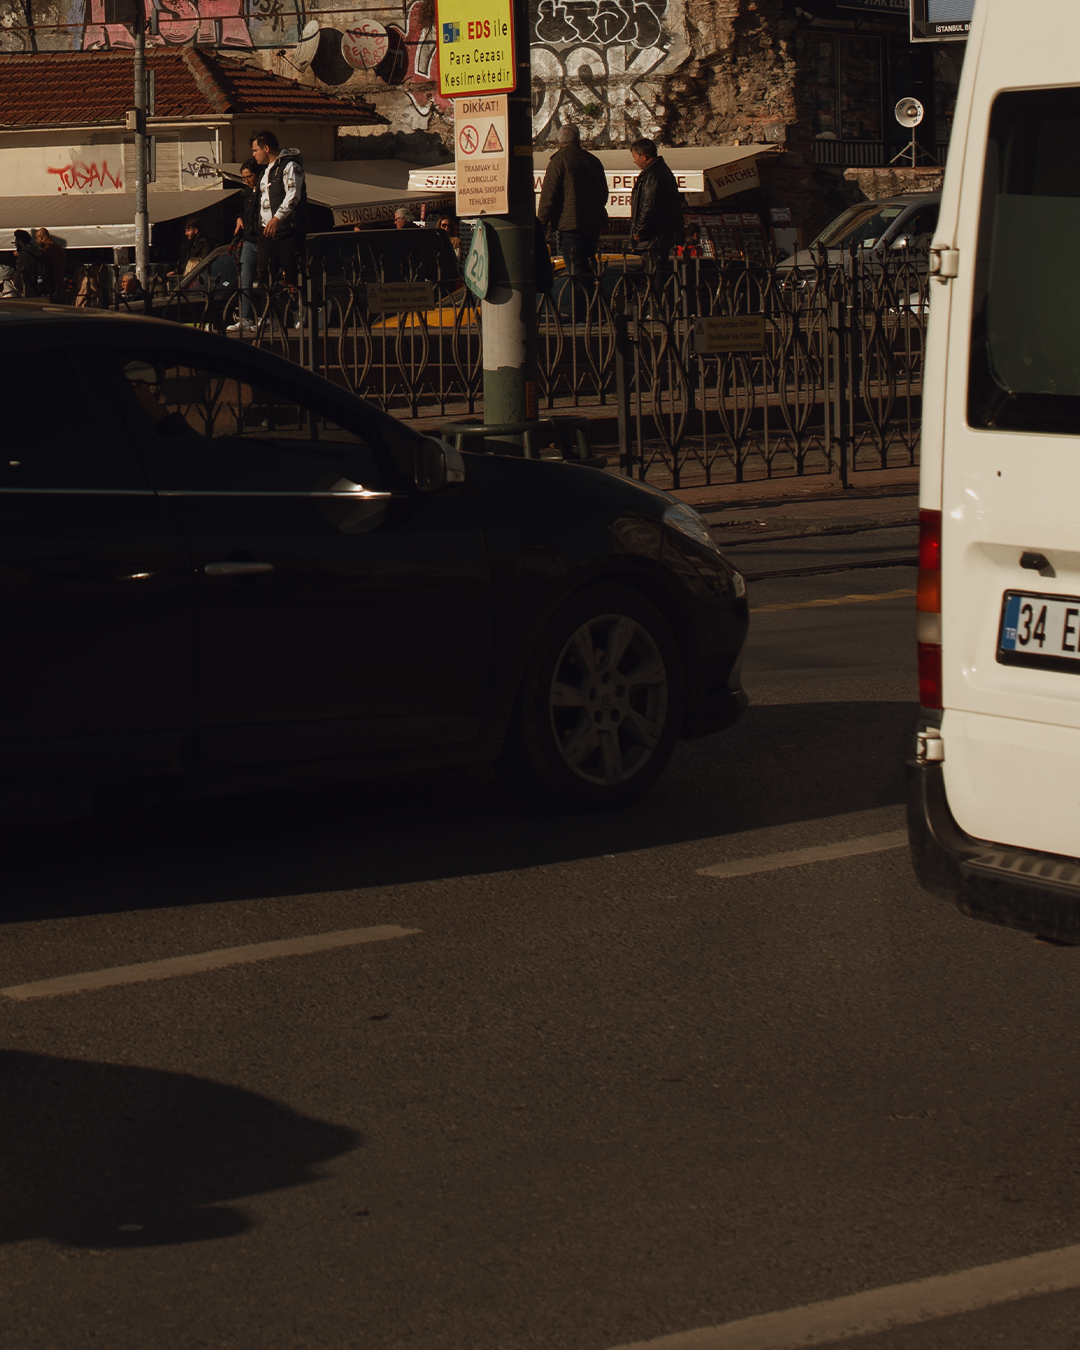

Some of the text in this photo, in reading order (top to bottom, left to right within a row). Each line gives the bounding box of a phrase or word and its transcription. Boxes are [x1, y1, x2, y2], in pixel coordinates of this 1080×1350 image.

[467, 18, 508, 40] EDS ile
[935, 24, 964, 33] İSTANBUL
[450, 48, 504, 66] Para Cezası
[444, 68, 510, 87] Kesilmektedir
[463, 100, 499, 114] DİKKAT!
[464, 162, 500, 173] TRAMVAY İLE
[425, 175, 457, 189] SUN
[467, 175, 498, 184] KORKULUK
[714, 167, 757, 188] WATCHES
[459, 186, 505, 196] ARASINA SIKIŞMA
[610, 195, 632, 206] PER
[379, 287, 388, 295] Ray
[708, 319, 759, 330] Ray Hattına Girmek
[708, 331, 760, 341] Tehlikeli Ve Yasaktır
[1005, 603, 1080, 653] TR 34 E
